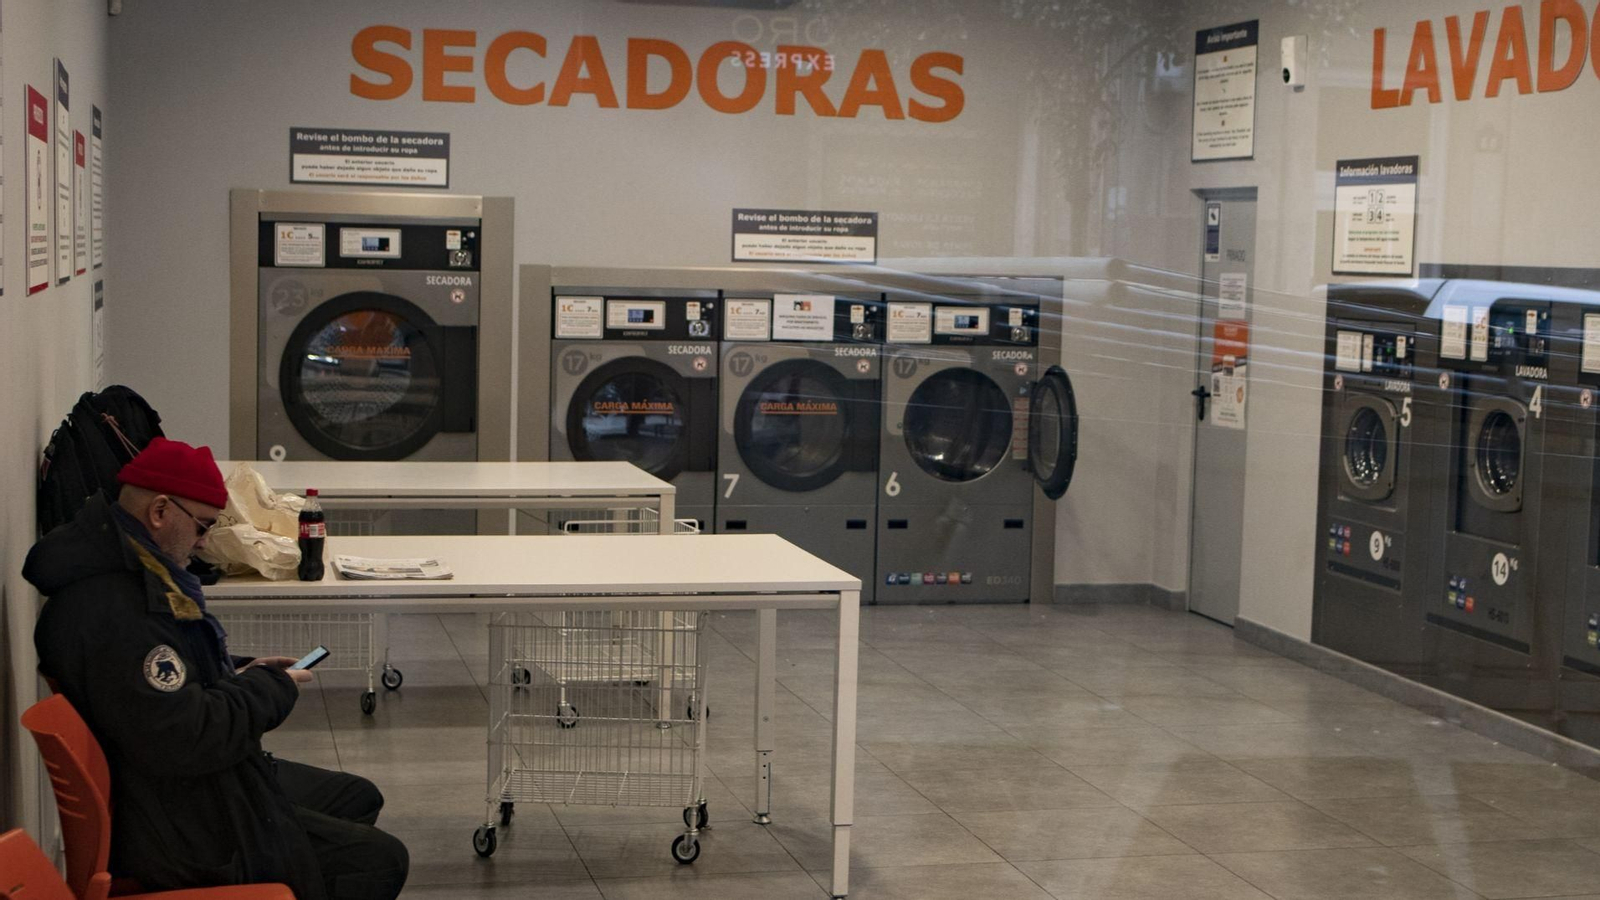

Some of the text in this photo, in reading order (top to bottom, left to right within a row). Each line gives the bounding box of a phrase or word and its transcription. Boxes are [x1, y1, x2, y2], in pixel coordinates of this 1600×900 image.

[349, 25, 965, 123] SECADORAS
[296, 132, 443, 146] Revise el bombo de la secadora
[353, 145, 389, 153] introducir
[401, 147, 418, 155] ropa
[1340, 163, 1413, 177] Información lavadoras
[738, 213, 767, 222] Revise
[769, 214, 777, 222] el
[779, 214, 809, 223] bombo
[810, 215, 821, 223] de
[823, 215, 831, 223] la
[833, 216, 872, 225] secadora
[833, 226, 849, 234] ropa
[426, 275, 472, 286] SECADORA
[667, 345, 712, 356] SECADORA
[834, 347, 877, 357] SECADORA
[992, 351, 1033, 360] SECADORA
[566, 355, 585, 371] 17
[732, 357, 750, 373] 17
[896, 359, 914, 375] 17
[1515, 365, 1548, 379] LAVADORA
[594, 399, 674, 411] CARGA MÁXIMA
[760, 400, 838, 411] CARGA MÁXIMA
[1529, 385, 1541, 418] 4
[1400, 397, 1412, 427] 5
[723, 473, 740, 499] 7
[885, 472, 901, 497] 6
[1374, 538, 1380, 553] 9
[1494, 560, 1507, 578] 14
